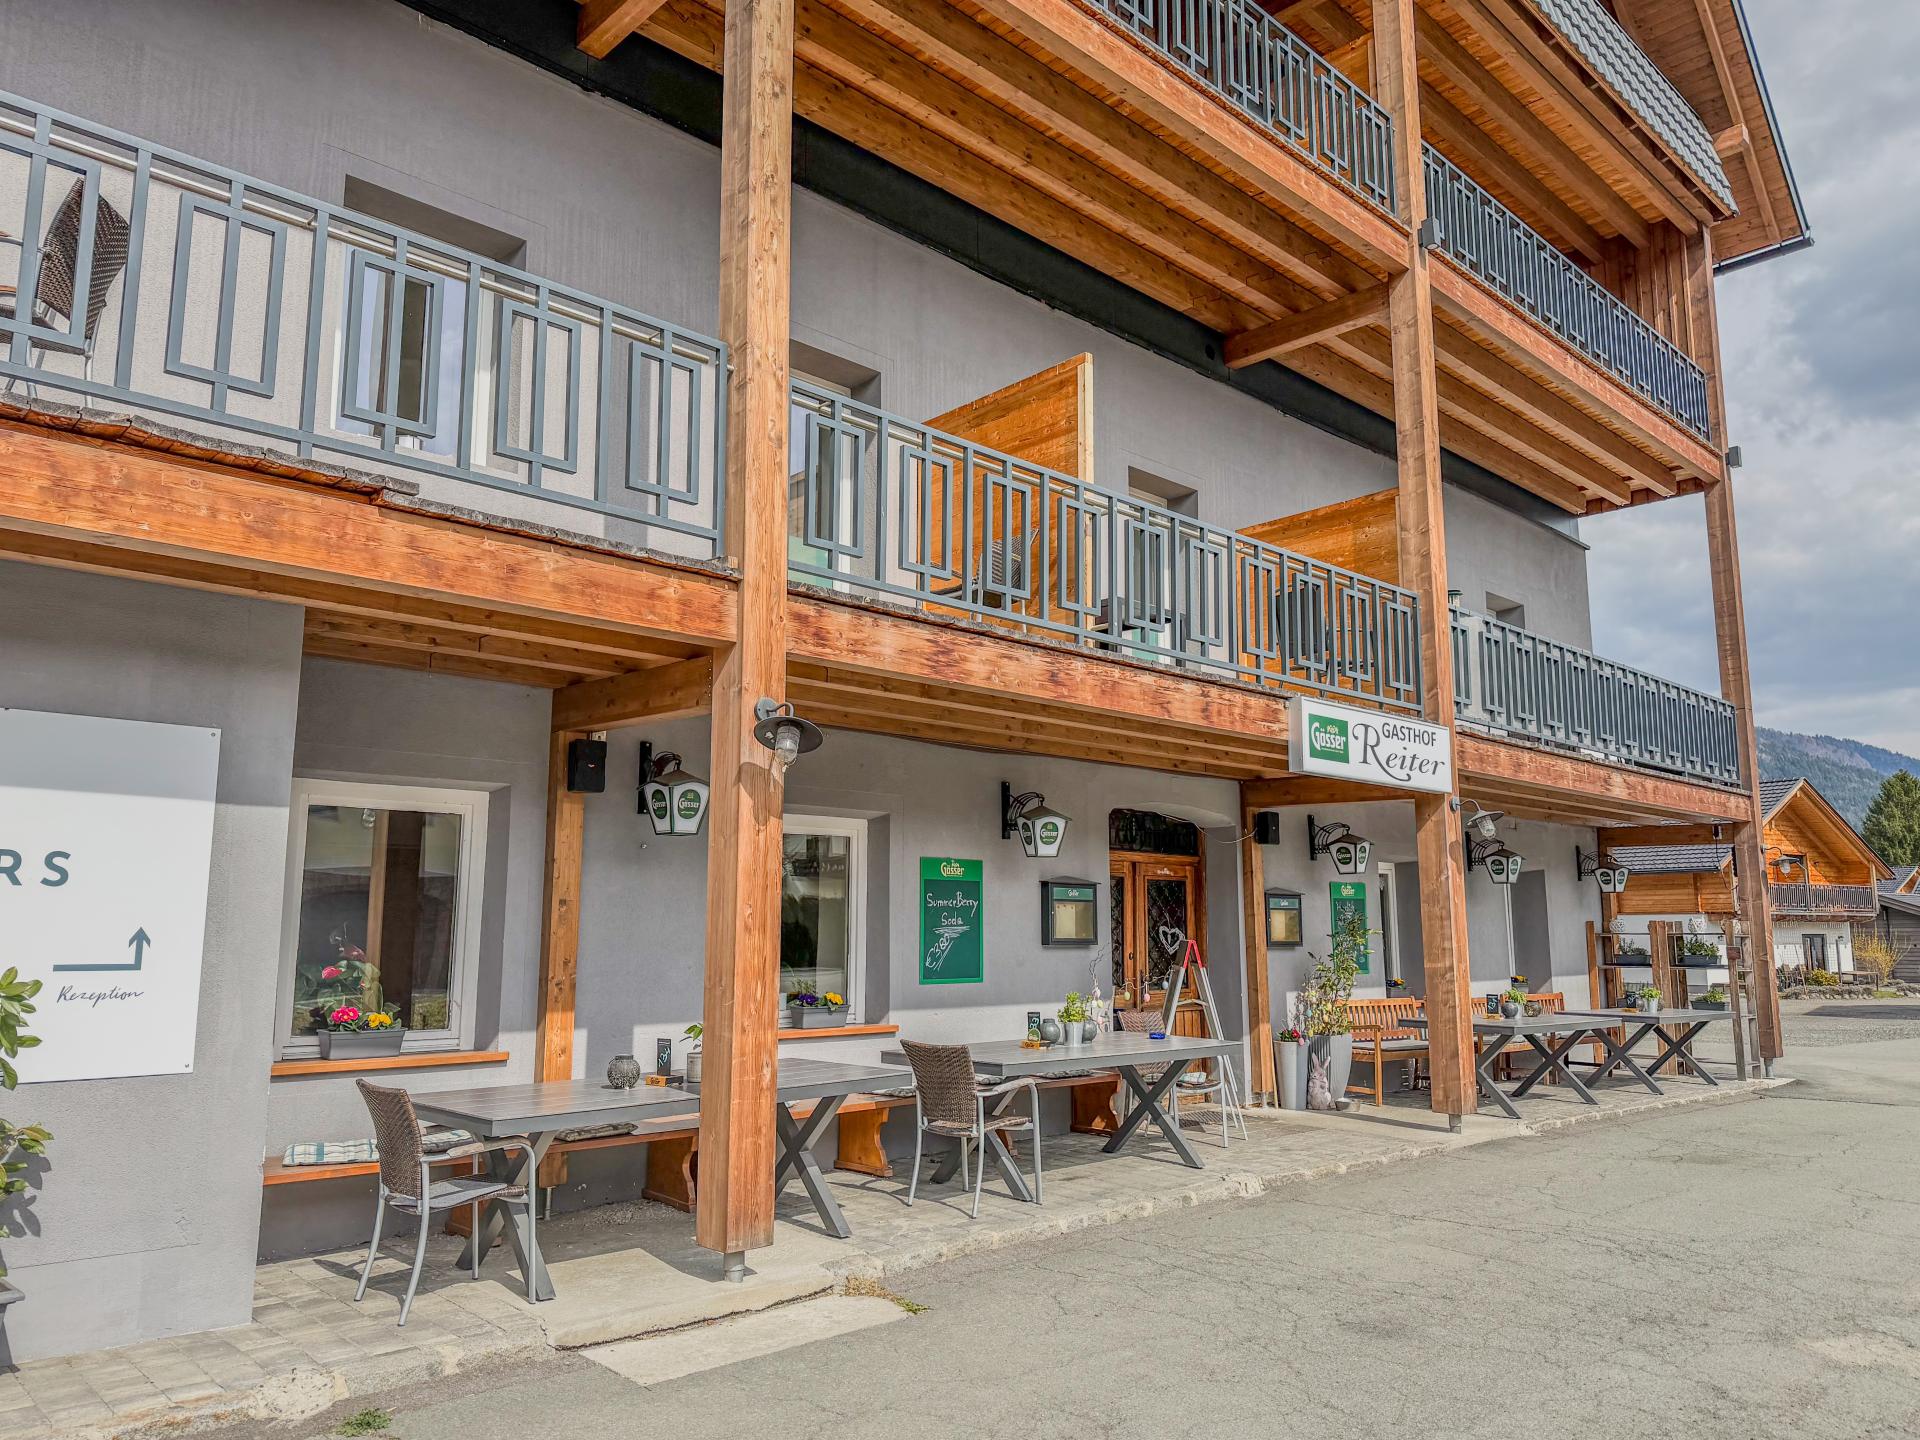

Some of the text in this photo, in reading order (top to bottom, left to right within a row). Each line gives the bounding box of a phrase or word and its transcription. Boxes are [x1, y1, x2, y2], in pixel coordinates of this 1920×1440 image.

[1311, 722, 1346, 750] Gösser
[1382, 722, 1437, 747] GASTHOF
[1352, 723, 1446, 782] Reiter
[941, 911, 964, 925] Soda
[57, 985, 145, 1008] Rezeption
